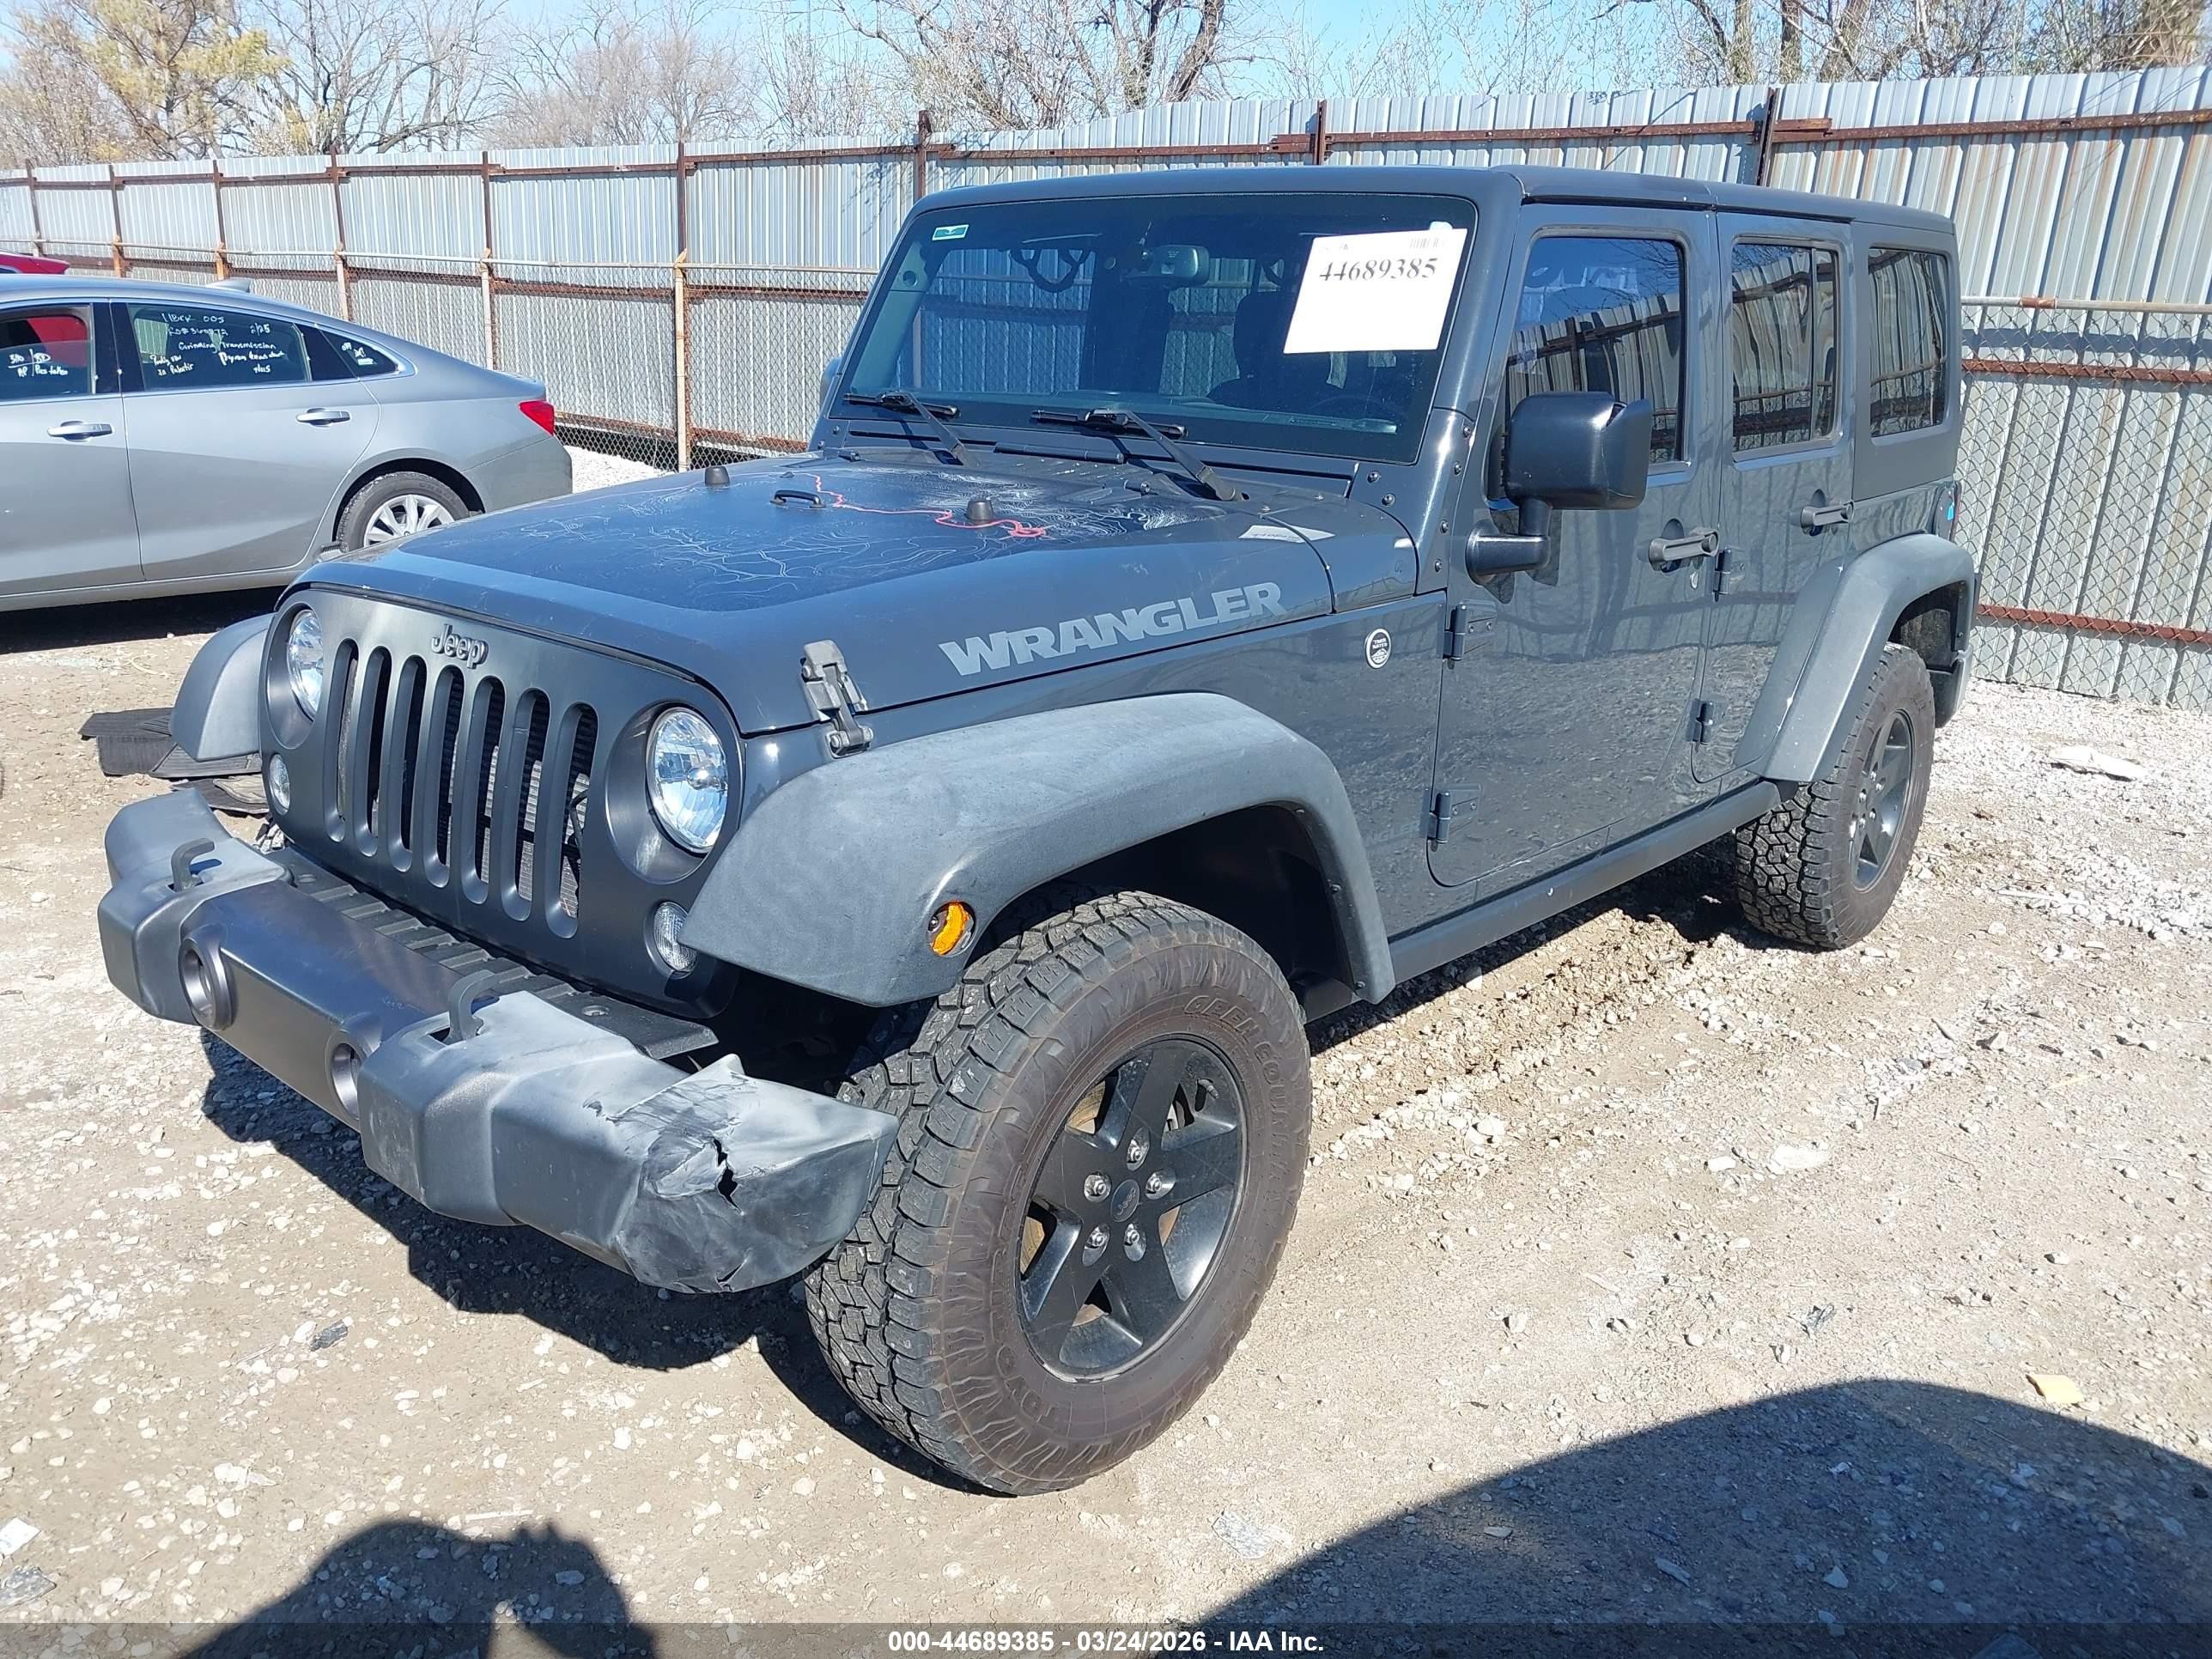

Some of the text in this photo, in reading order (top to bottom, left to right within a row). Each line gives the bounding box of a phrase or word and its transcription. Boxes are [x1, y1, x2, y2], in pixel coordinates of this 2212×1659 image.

[1318, 258, 1438, 282] 44689385
[431, 623, 489, 669] Jeep
[939, 582, 1287, 676] WRANGLER
